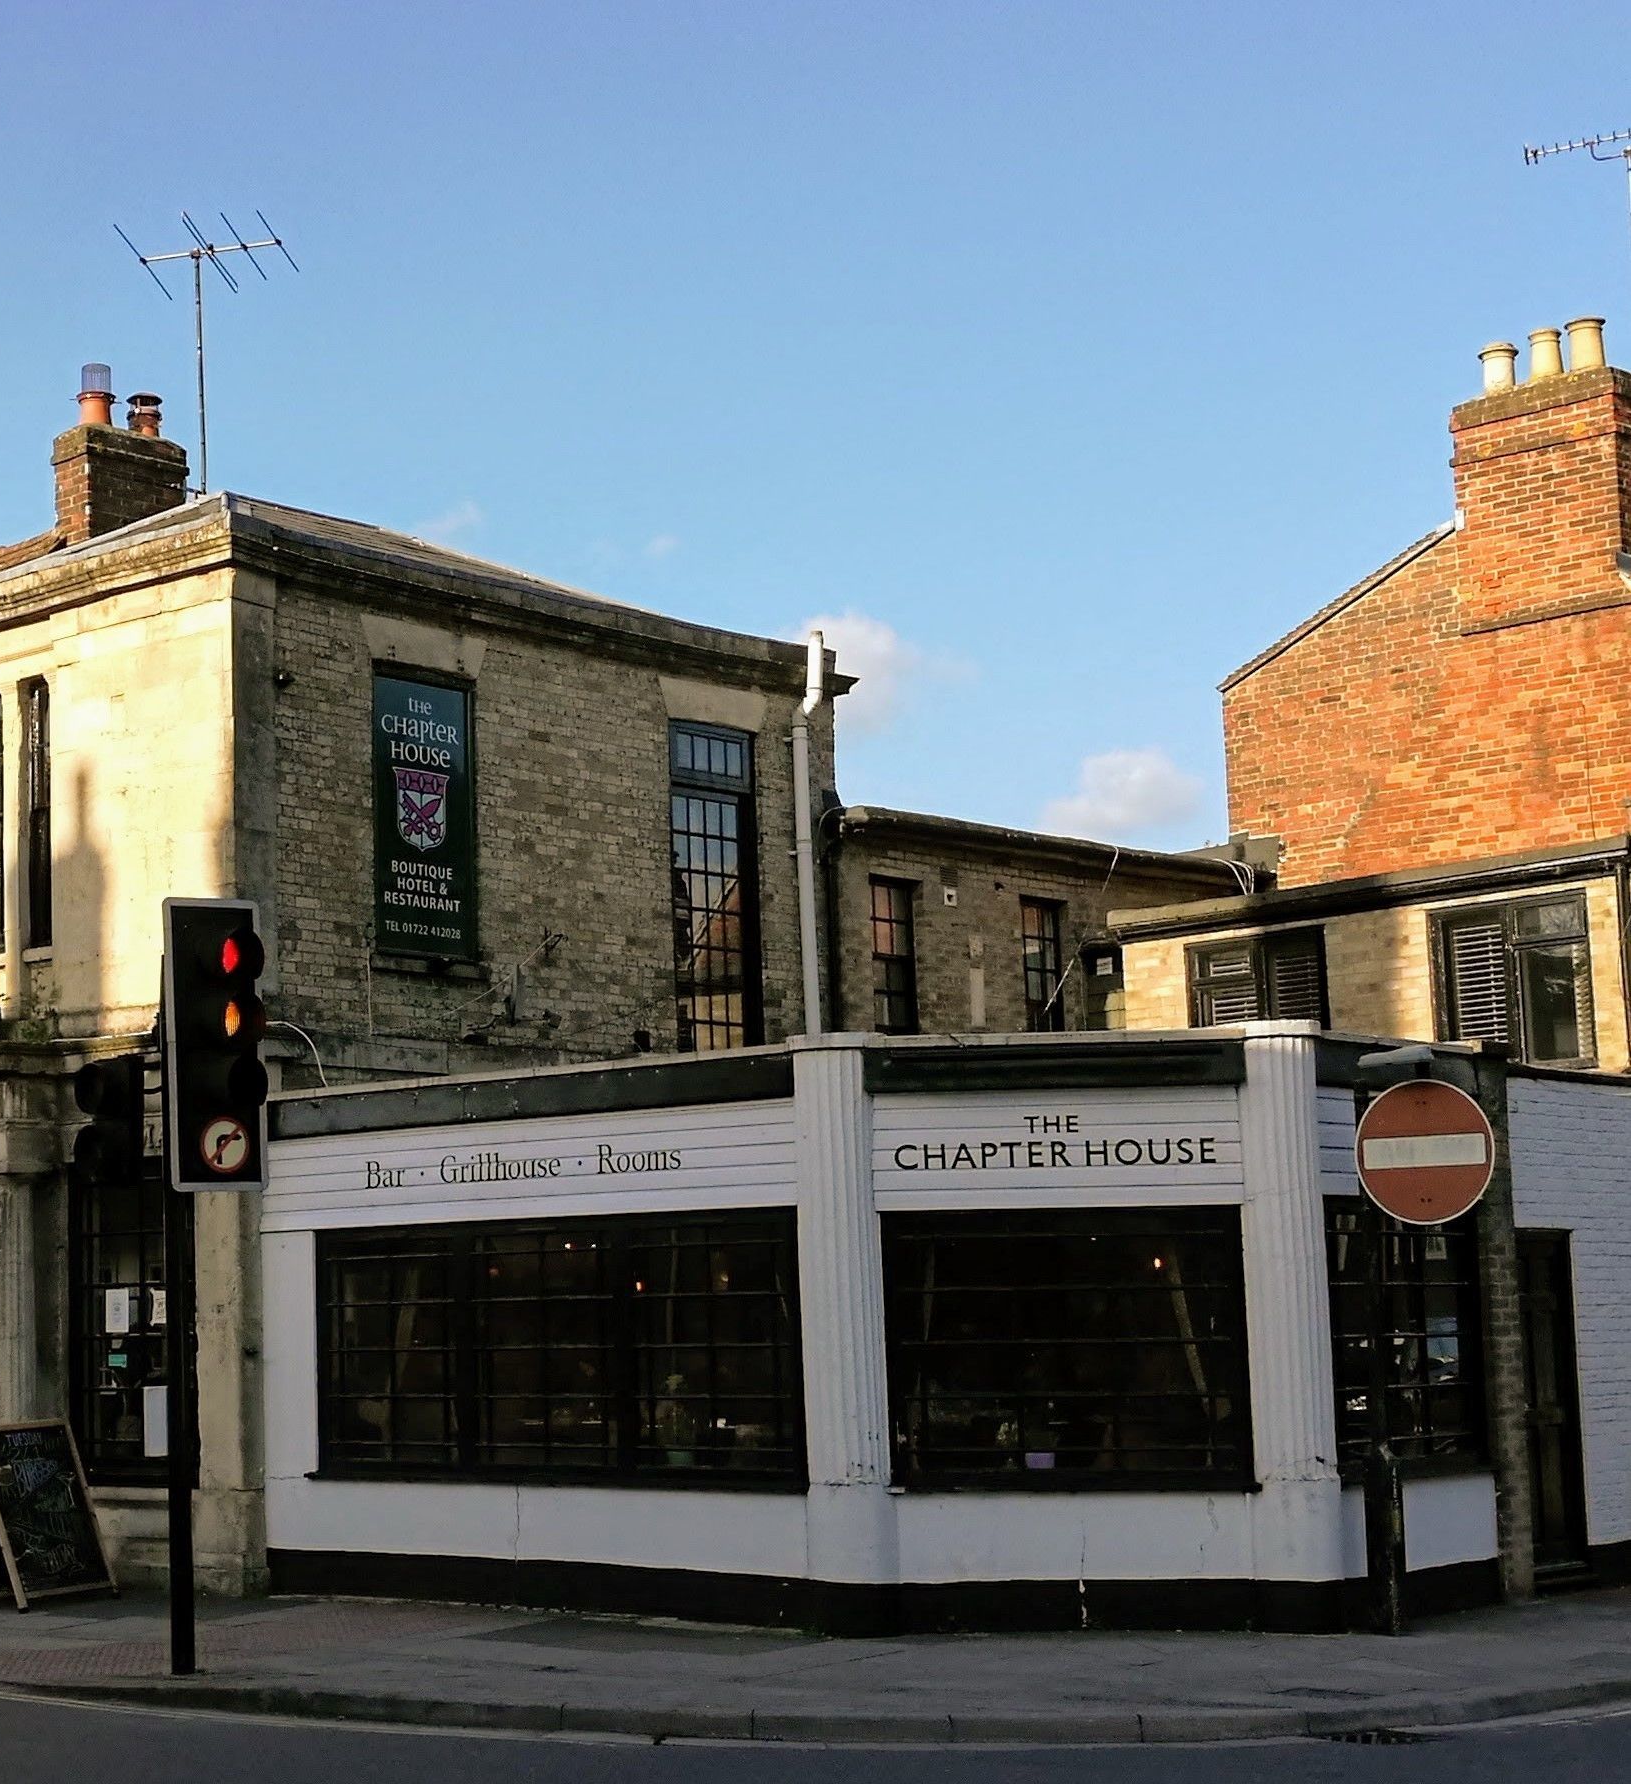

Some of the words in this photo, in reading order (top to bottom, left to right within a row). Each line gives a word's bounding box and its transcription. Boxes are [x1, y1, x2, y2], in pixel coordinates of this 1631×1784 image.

[391, 859, 453, 880] BOUTIQUE
[397, 876, 436, 894] HOTEL
[439, 882, 449, 896] &
[384, 890, 461, 913] RESTAURANT
[385, 920, 401, 932] TEL
[402, 922, 429, 936] 01722
[1023, 1115, 1080, 1134] THE
[894, 1140, 1072, 1170] CHAPTER
[1085, 1137, 1217, 1167] HOUSE
[365, 1160, 406, 1190] Bar
[439, 1151, 561, 1184] Grillhouse
[596, 1143, 682, 1175] Rooms
